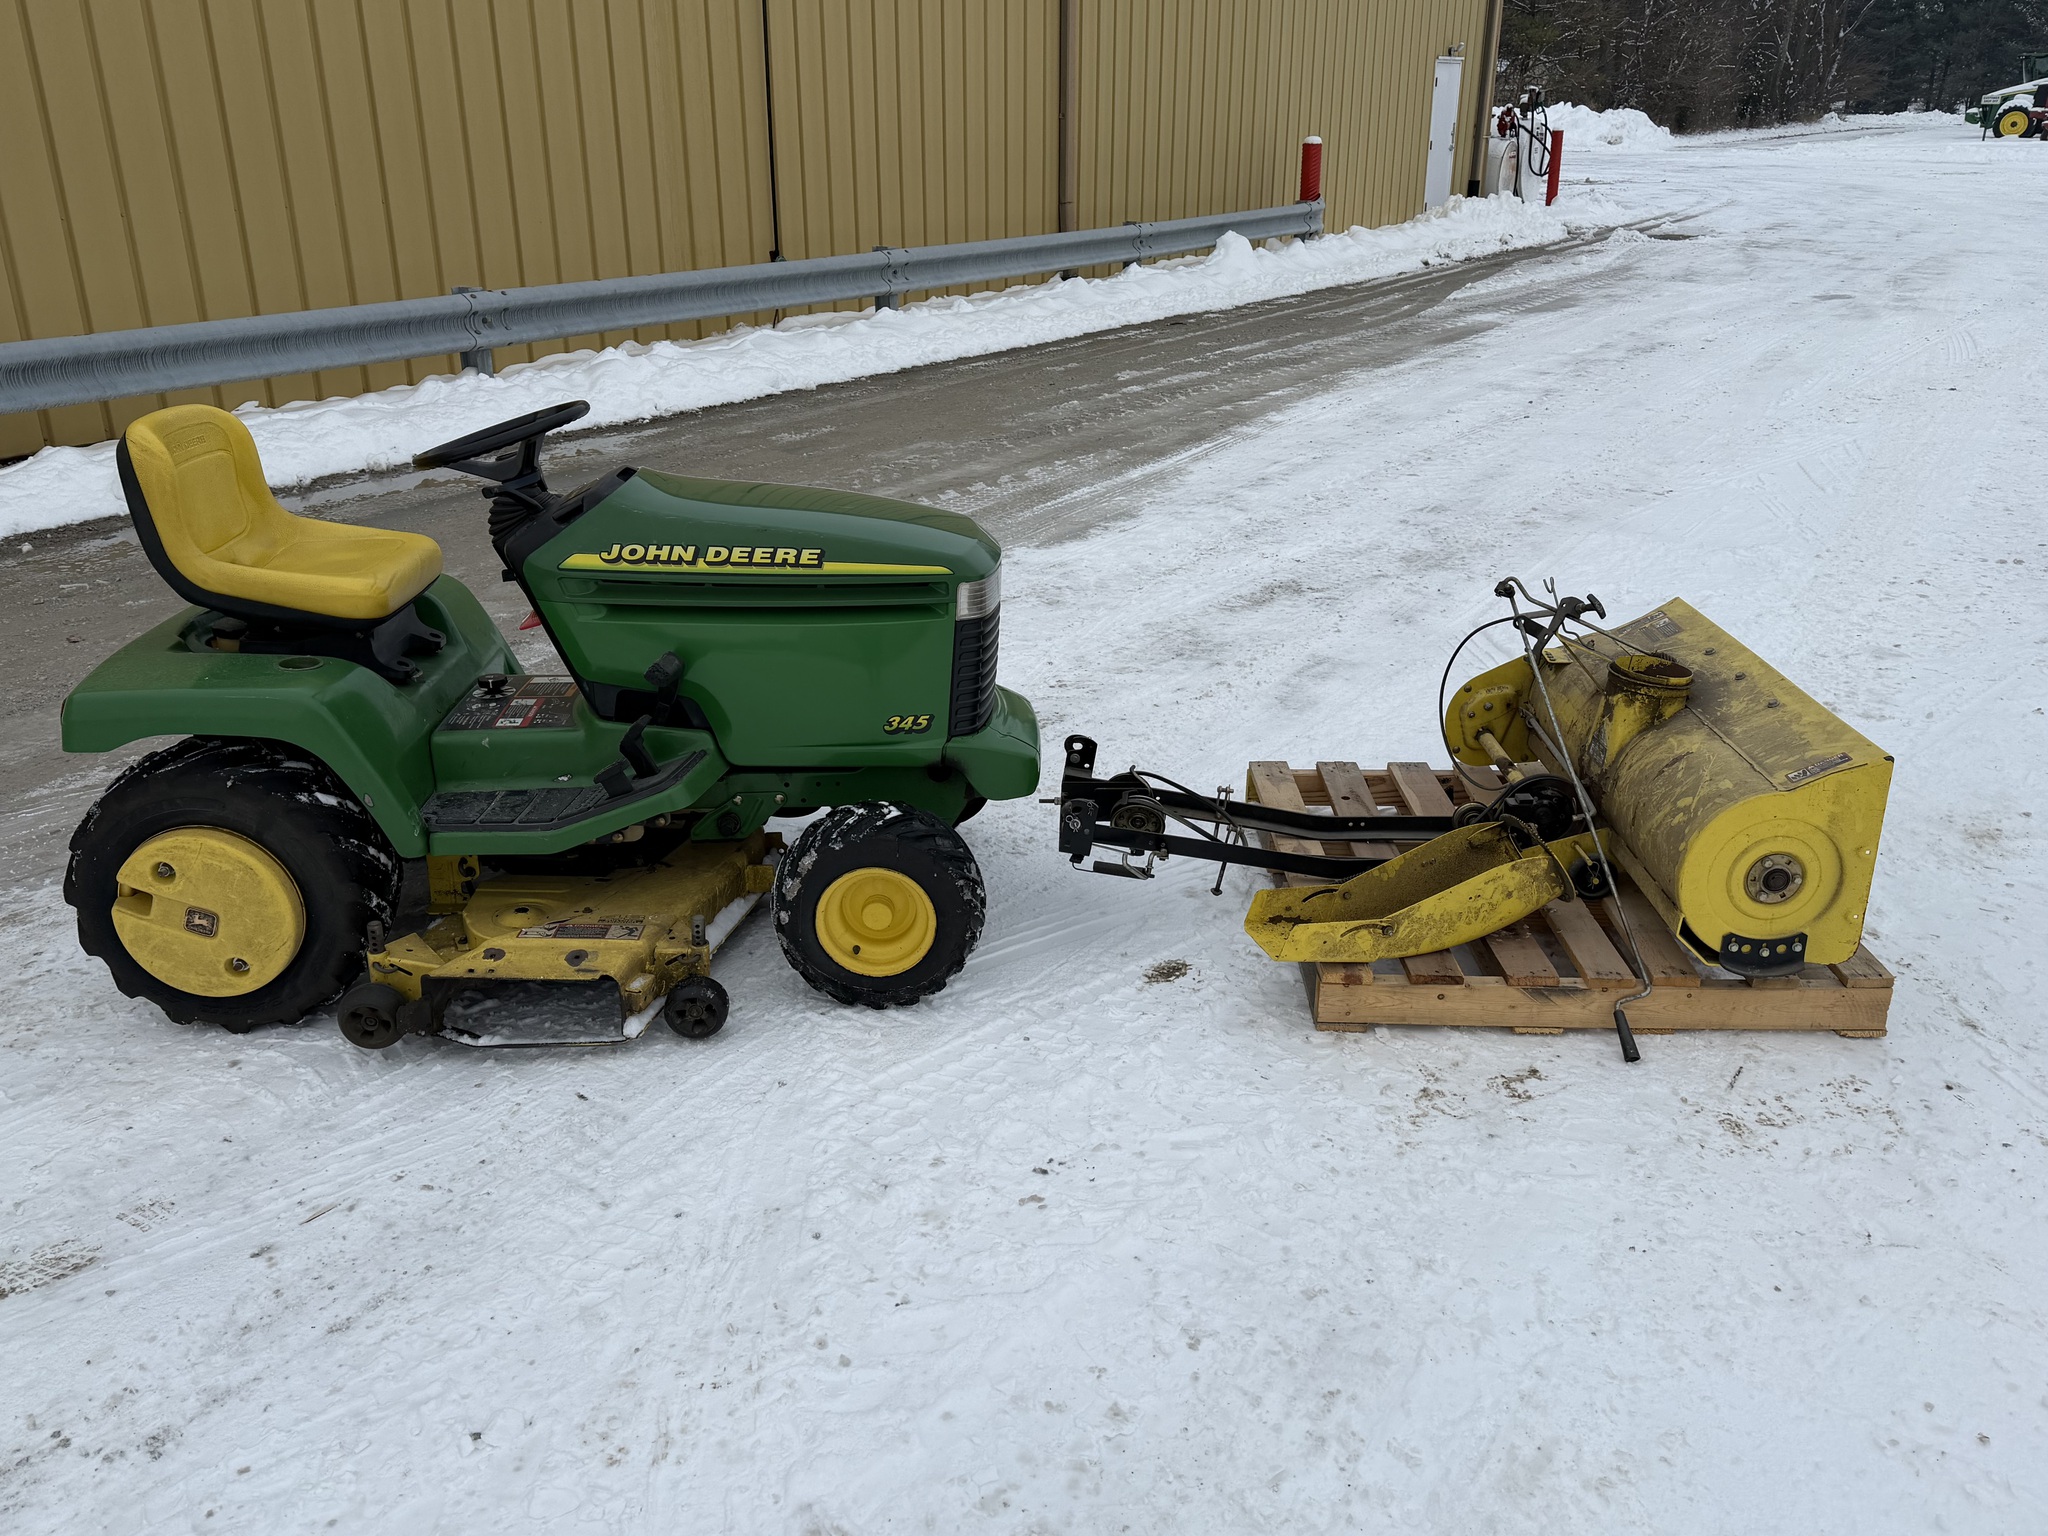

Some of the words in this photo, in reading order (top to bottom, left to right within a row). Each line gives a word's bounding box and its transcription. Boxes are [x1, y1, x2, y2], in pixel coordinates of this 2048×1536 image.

[600, 544, 699, 565] JOHN
[704, 546, 823, 568] DEERE
[883, 715, 933, 734] 345
